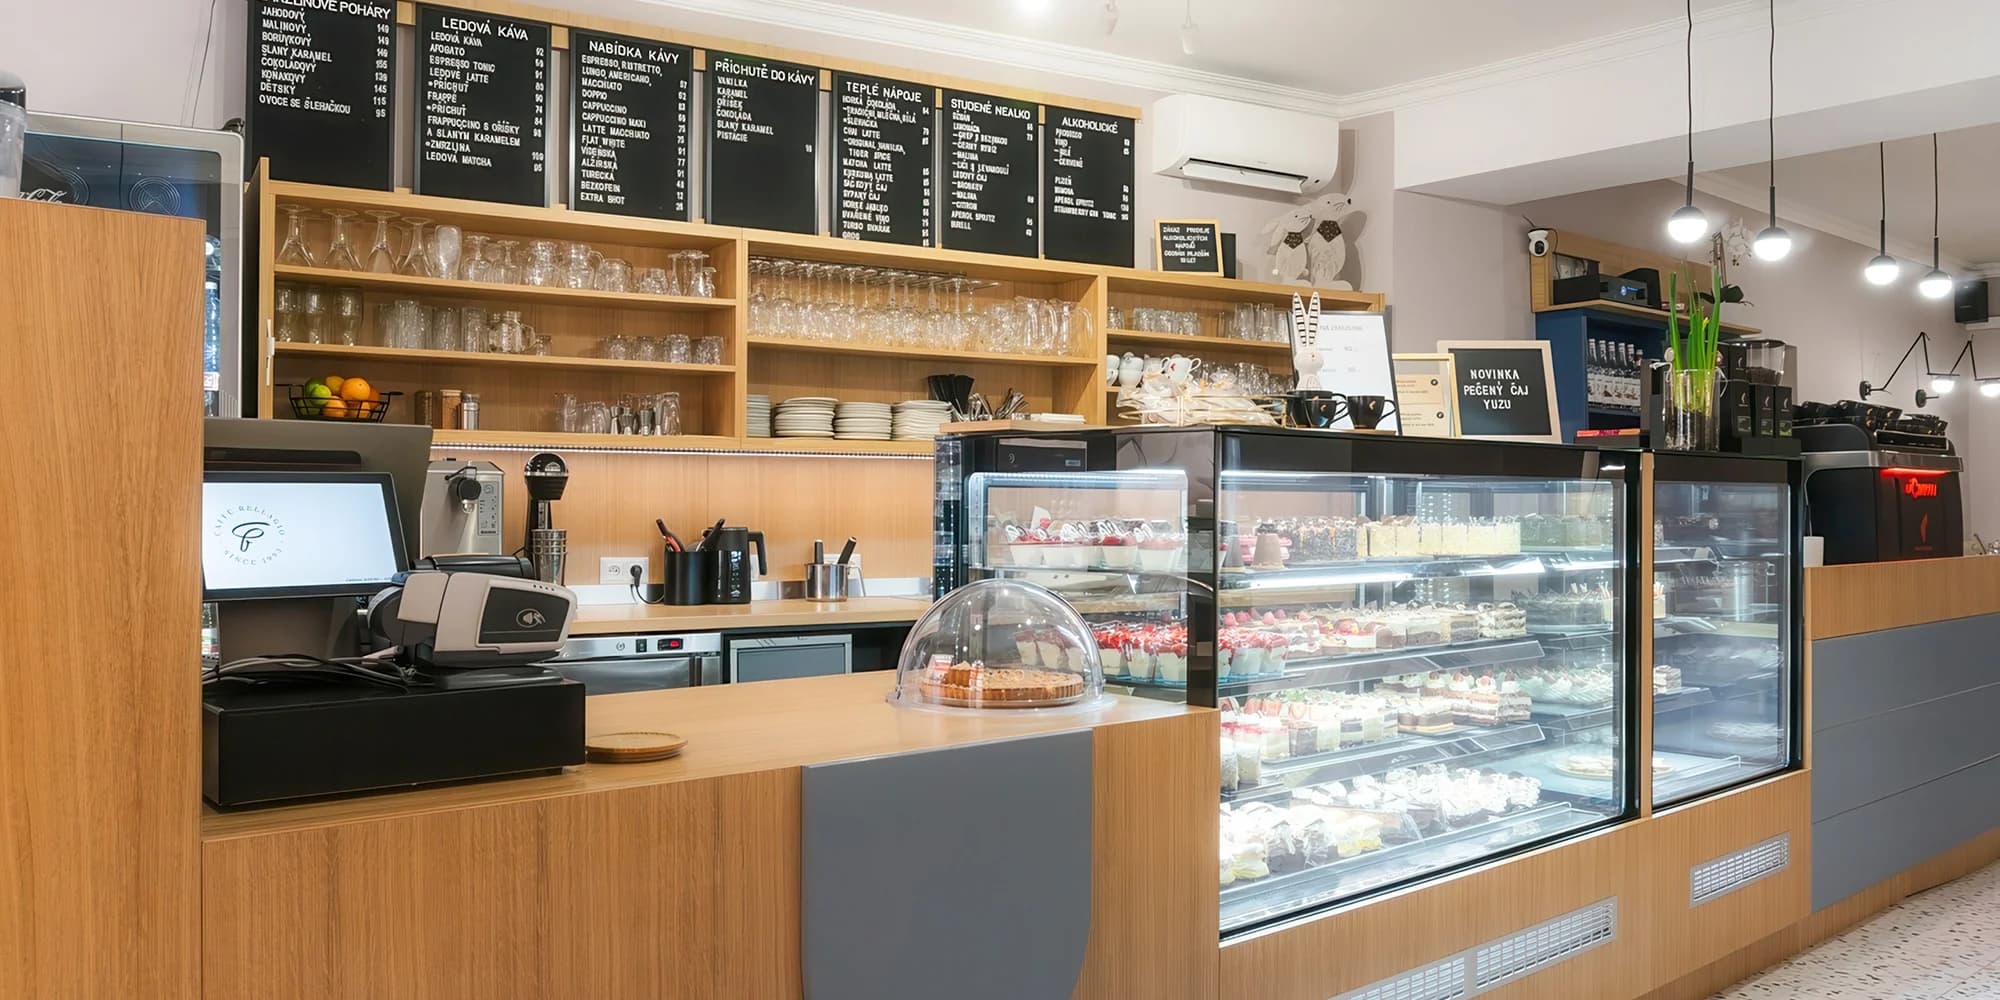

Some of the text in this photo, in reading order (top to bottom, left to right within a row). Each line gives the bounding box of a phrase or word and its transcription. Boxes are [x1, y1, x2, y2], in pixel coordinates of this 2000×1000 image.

[340, 2, 391, 20] POHÁRY
[443, 17, 528, 40] LEDOVÁ KÁVA
[431, 31, 460, 44] LEDOVÁ
[291, 48, 332, 62] KARAMEL
[590, 41, 679, 64] NABÍDKA KÁVY
[430, 55, 470, 69] ESPRESSO
[467, 72, 488, 83] LATTE
[715, 58, 814, 85] PŘÍCHUTĚ DO KÁVY
[846, 82, 921, 102] TEPLÉ NÁPOJE
[259, 94, 386, 117] OVOCE SE ŠLEHAČKOU 95
[583, 101, 627, 114] CAPPUCCINO
[951, 99, 1030, 120] STUDENÉ NEALKO
[428, 115, 480, 129] FRAPPUCCINO
[484, 122, 489, 131] S
[582, 112, 627, 125] CAPPUCCINO
[1062, 117, 1118, 134] ALKOHOLICKÉ
[583, 124, 605, 134] LATTE
[427, 128, 432, 136] A
[474, 133, 520, 146] KARAMELEM
[462, 155, 492, 167] MATCHA
[581, 192, 603, 202] EXTRA
[1470, 369, 1519, 380] NOVINKA
[1463, 381, 1529, 396] PEČENÝ ČAJ
[1483, 399, 1512, 410] YUZU
